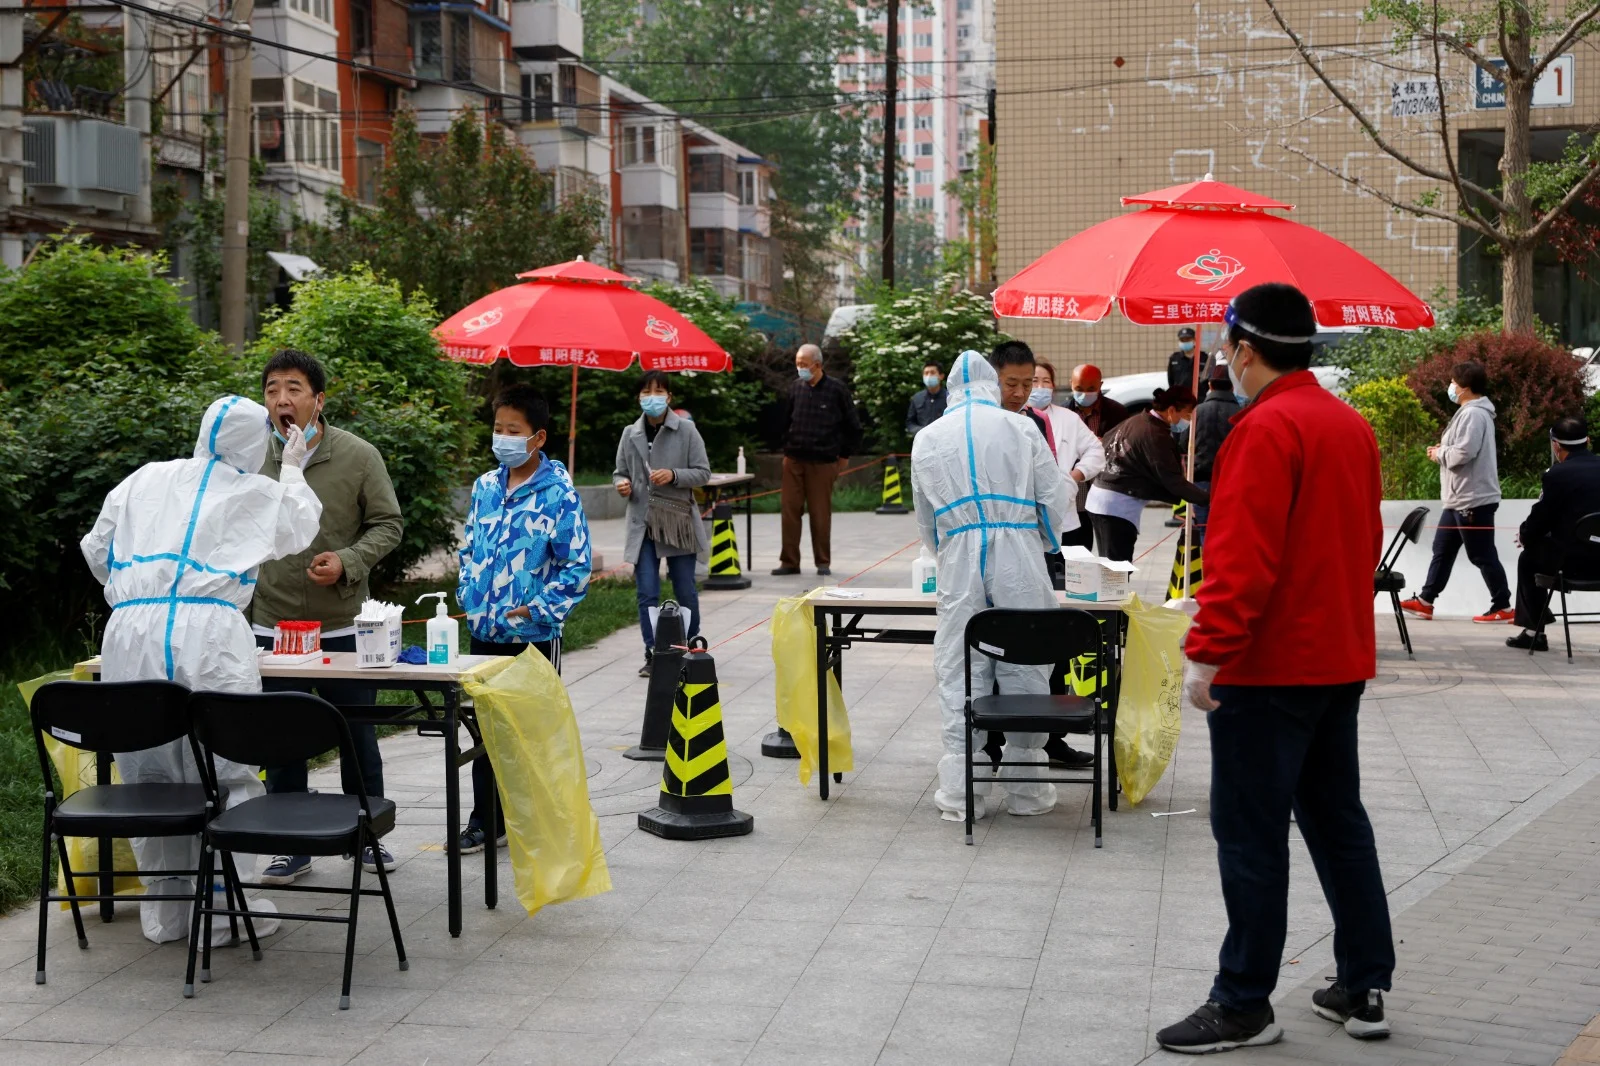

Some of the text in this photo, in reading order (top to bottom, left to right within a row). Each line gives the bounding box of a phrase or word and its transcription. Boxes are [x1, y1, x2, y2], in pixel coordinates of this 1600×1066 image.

[1553, 65, 1563, 97] 1
[1482, 92, 1506, 104] CHUN
[1022, 295, 1080, 317] 朝阳群众
[1151, 302, 1230, 319] 三里屯治安
[1341, 304, 1398, 324] 朝阳群众
[539, 347, 600, 365] 朝阳群众
